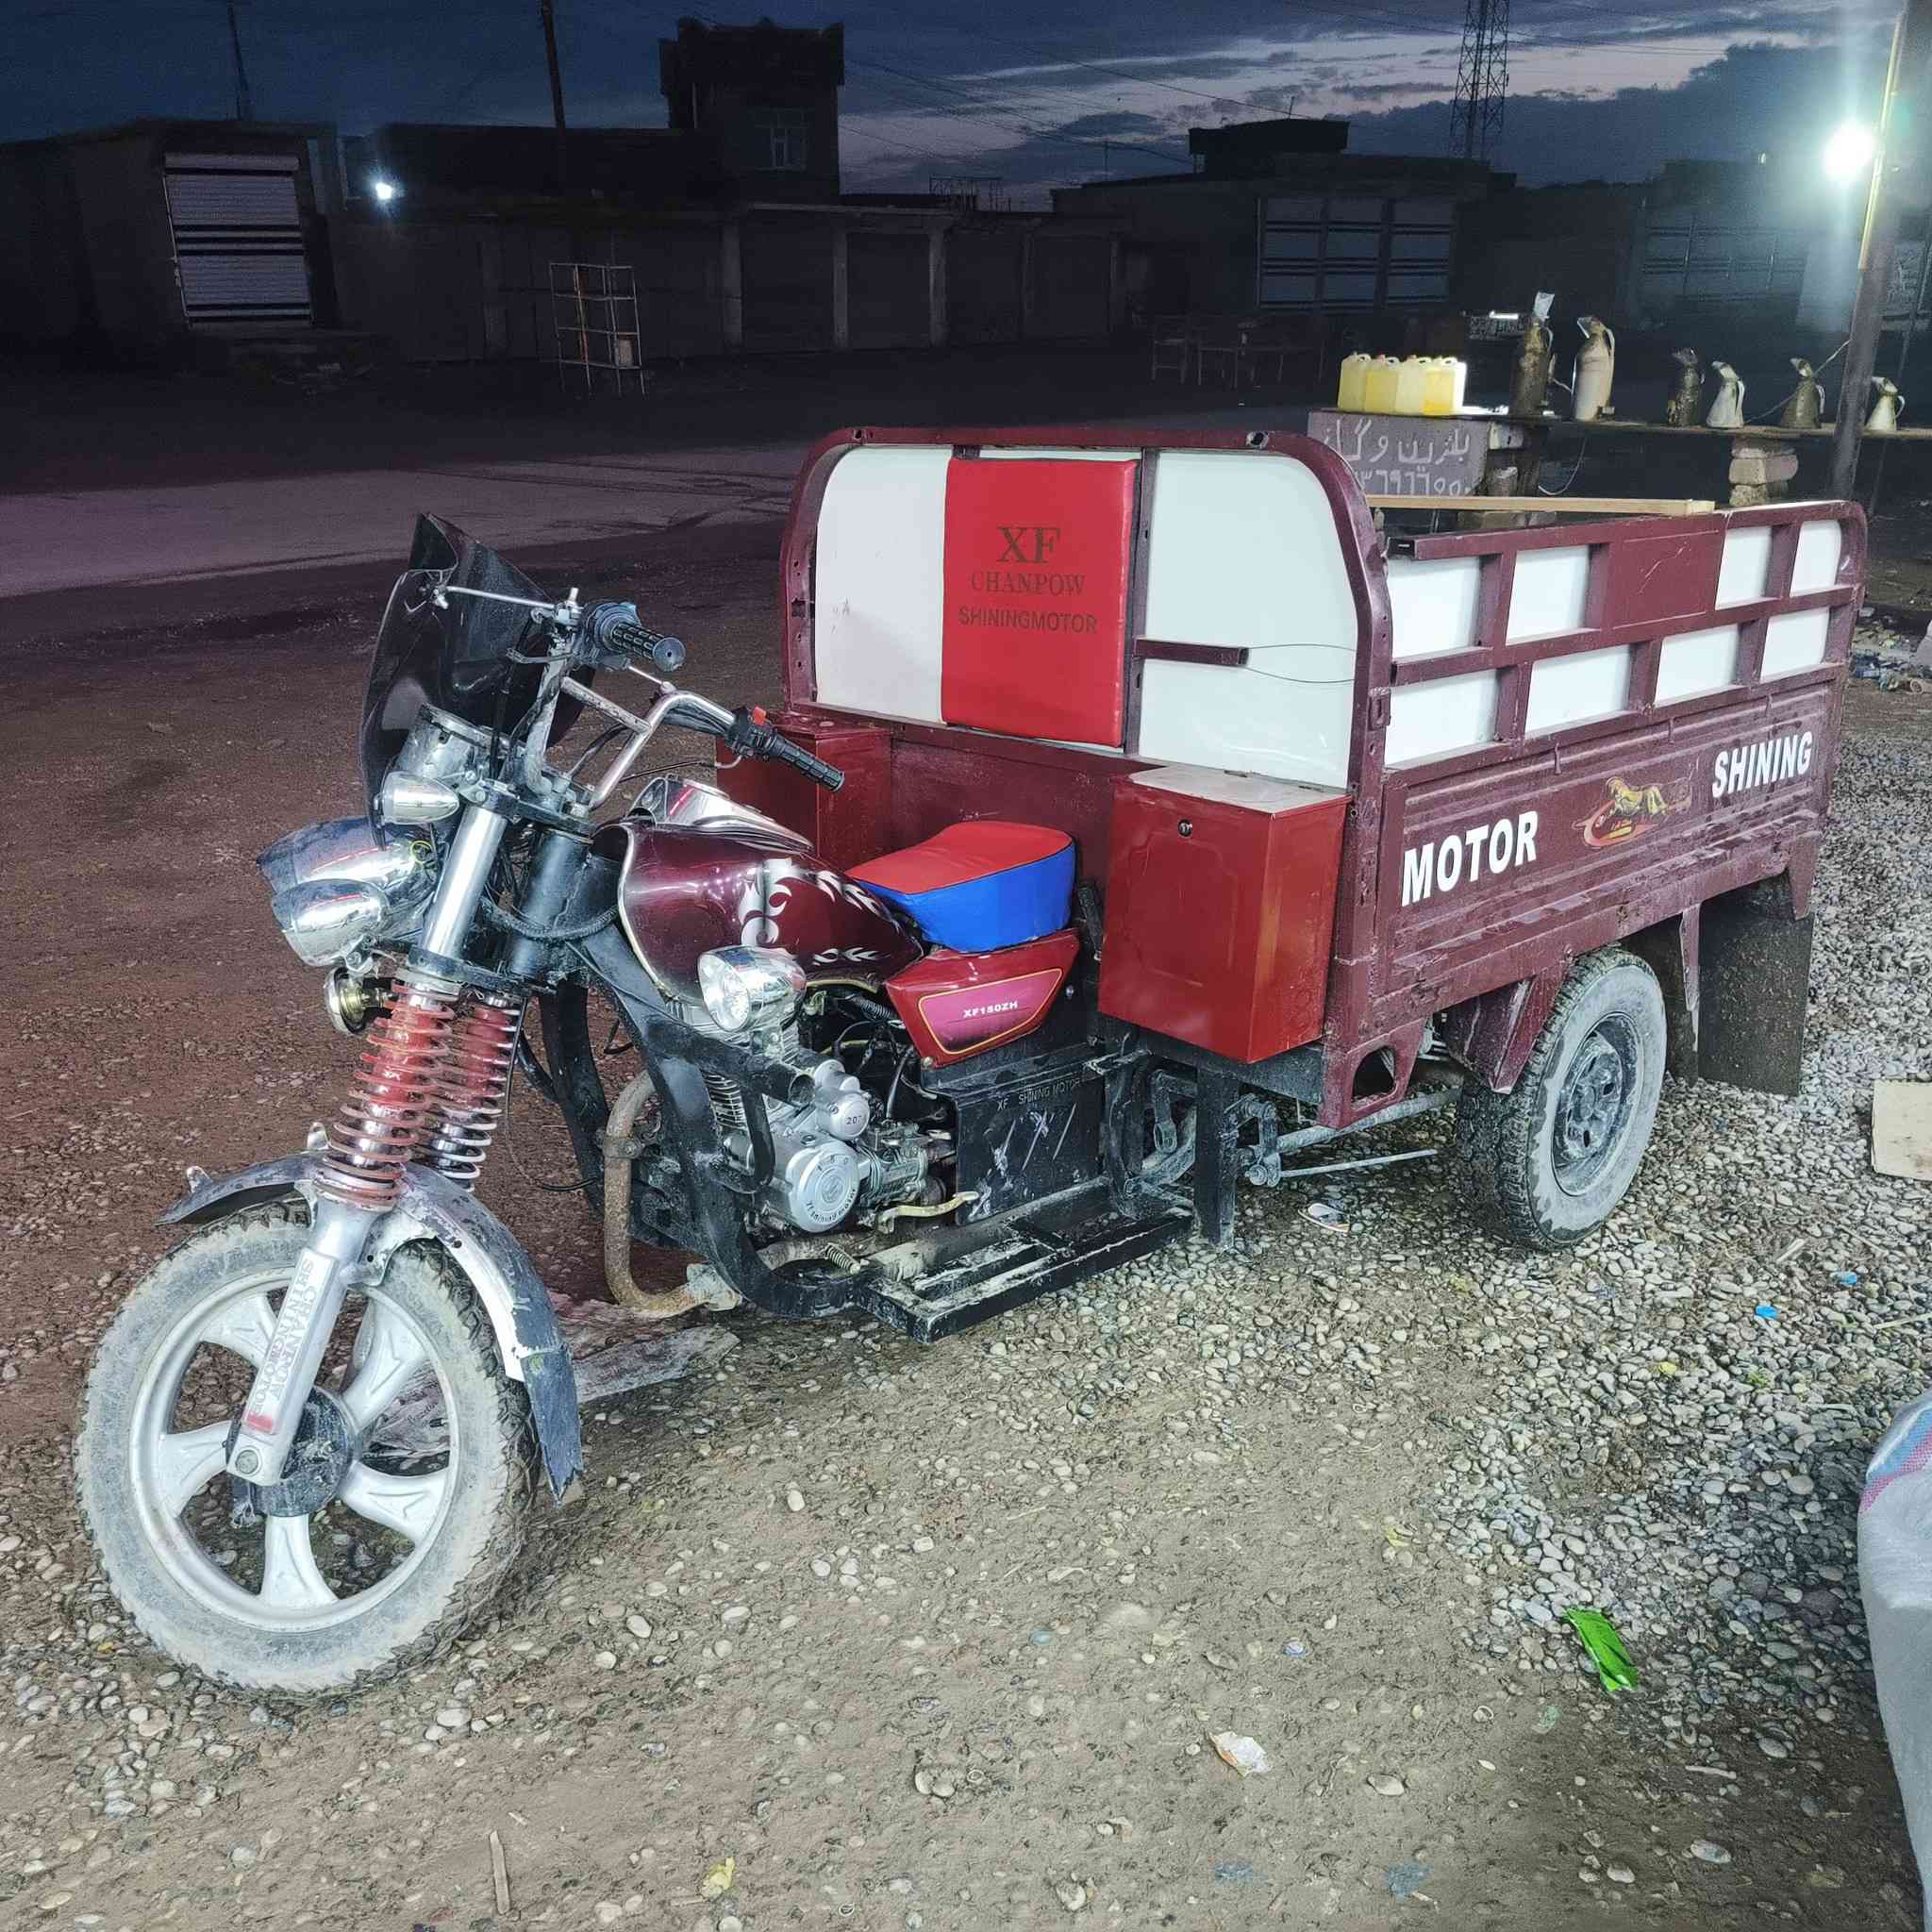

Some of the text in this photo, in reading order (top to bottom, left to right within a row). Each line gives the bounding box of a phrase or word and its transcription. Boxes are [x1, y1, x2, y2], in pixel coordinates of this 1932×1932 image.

[1369, 436, 1389, 463] و
[996, 526, 1060, 563] XF
[971, 571, 1085, 595] CHANPOW
[959, 605, 1096, 633] SHININGMOTOR
[1401, 731, 1813, 907] MOTOR SHINING
[962, 1000, 1019, 1019] XF150ZH
